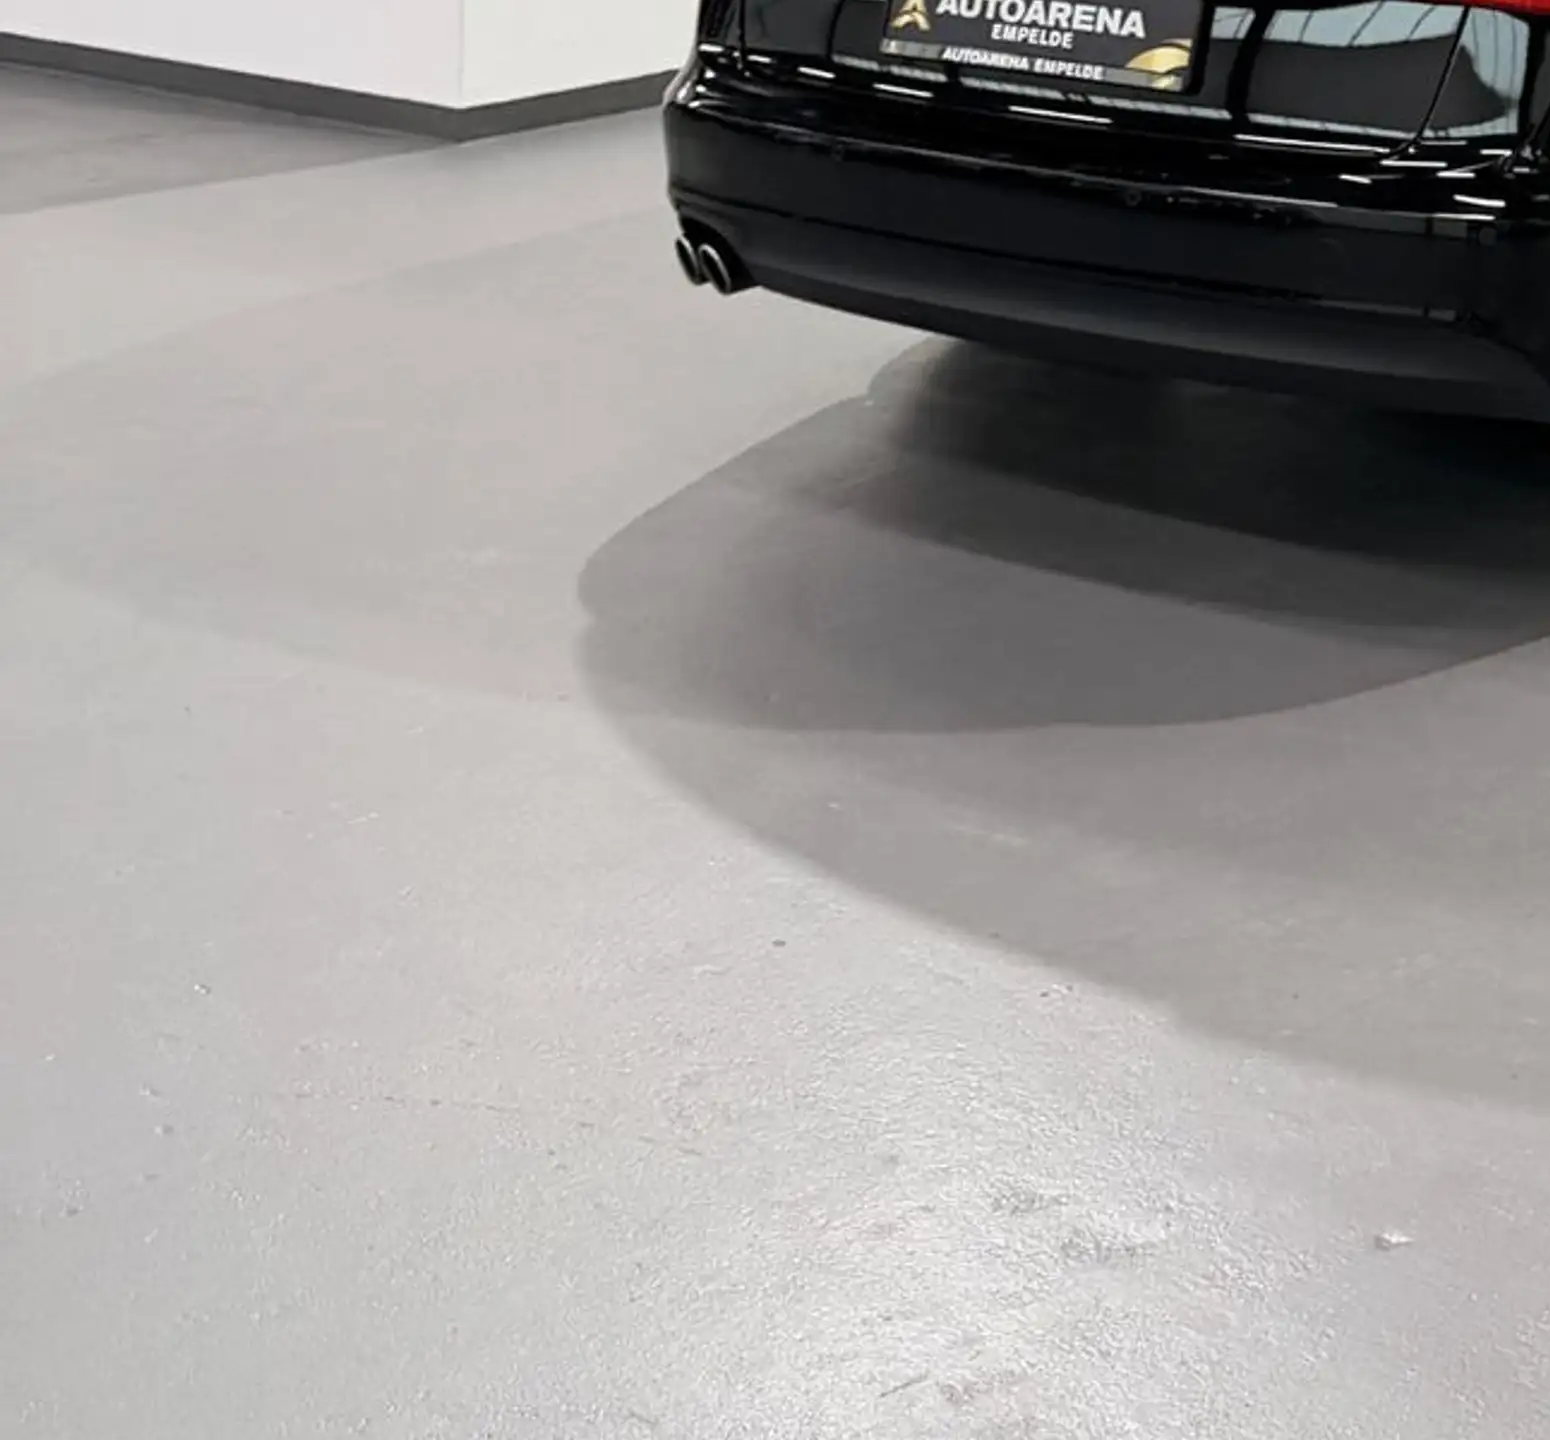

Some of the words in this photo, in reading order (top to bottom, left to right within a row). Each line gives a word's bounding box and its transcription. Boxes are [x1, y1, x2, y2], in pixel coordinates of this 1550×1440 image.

[990, 23, 1075, 50] EMPELDE
[941, 45, 1030, 72] AUTOARENA
[1033, 57, 1105, 81] EMPELDE
